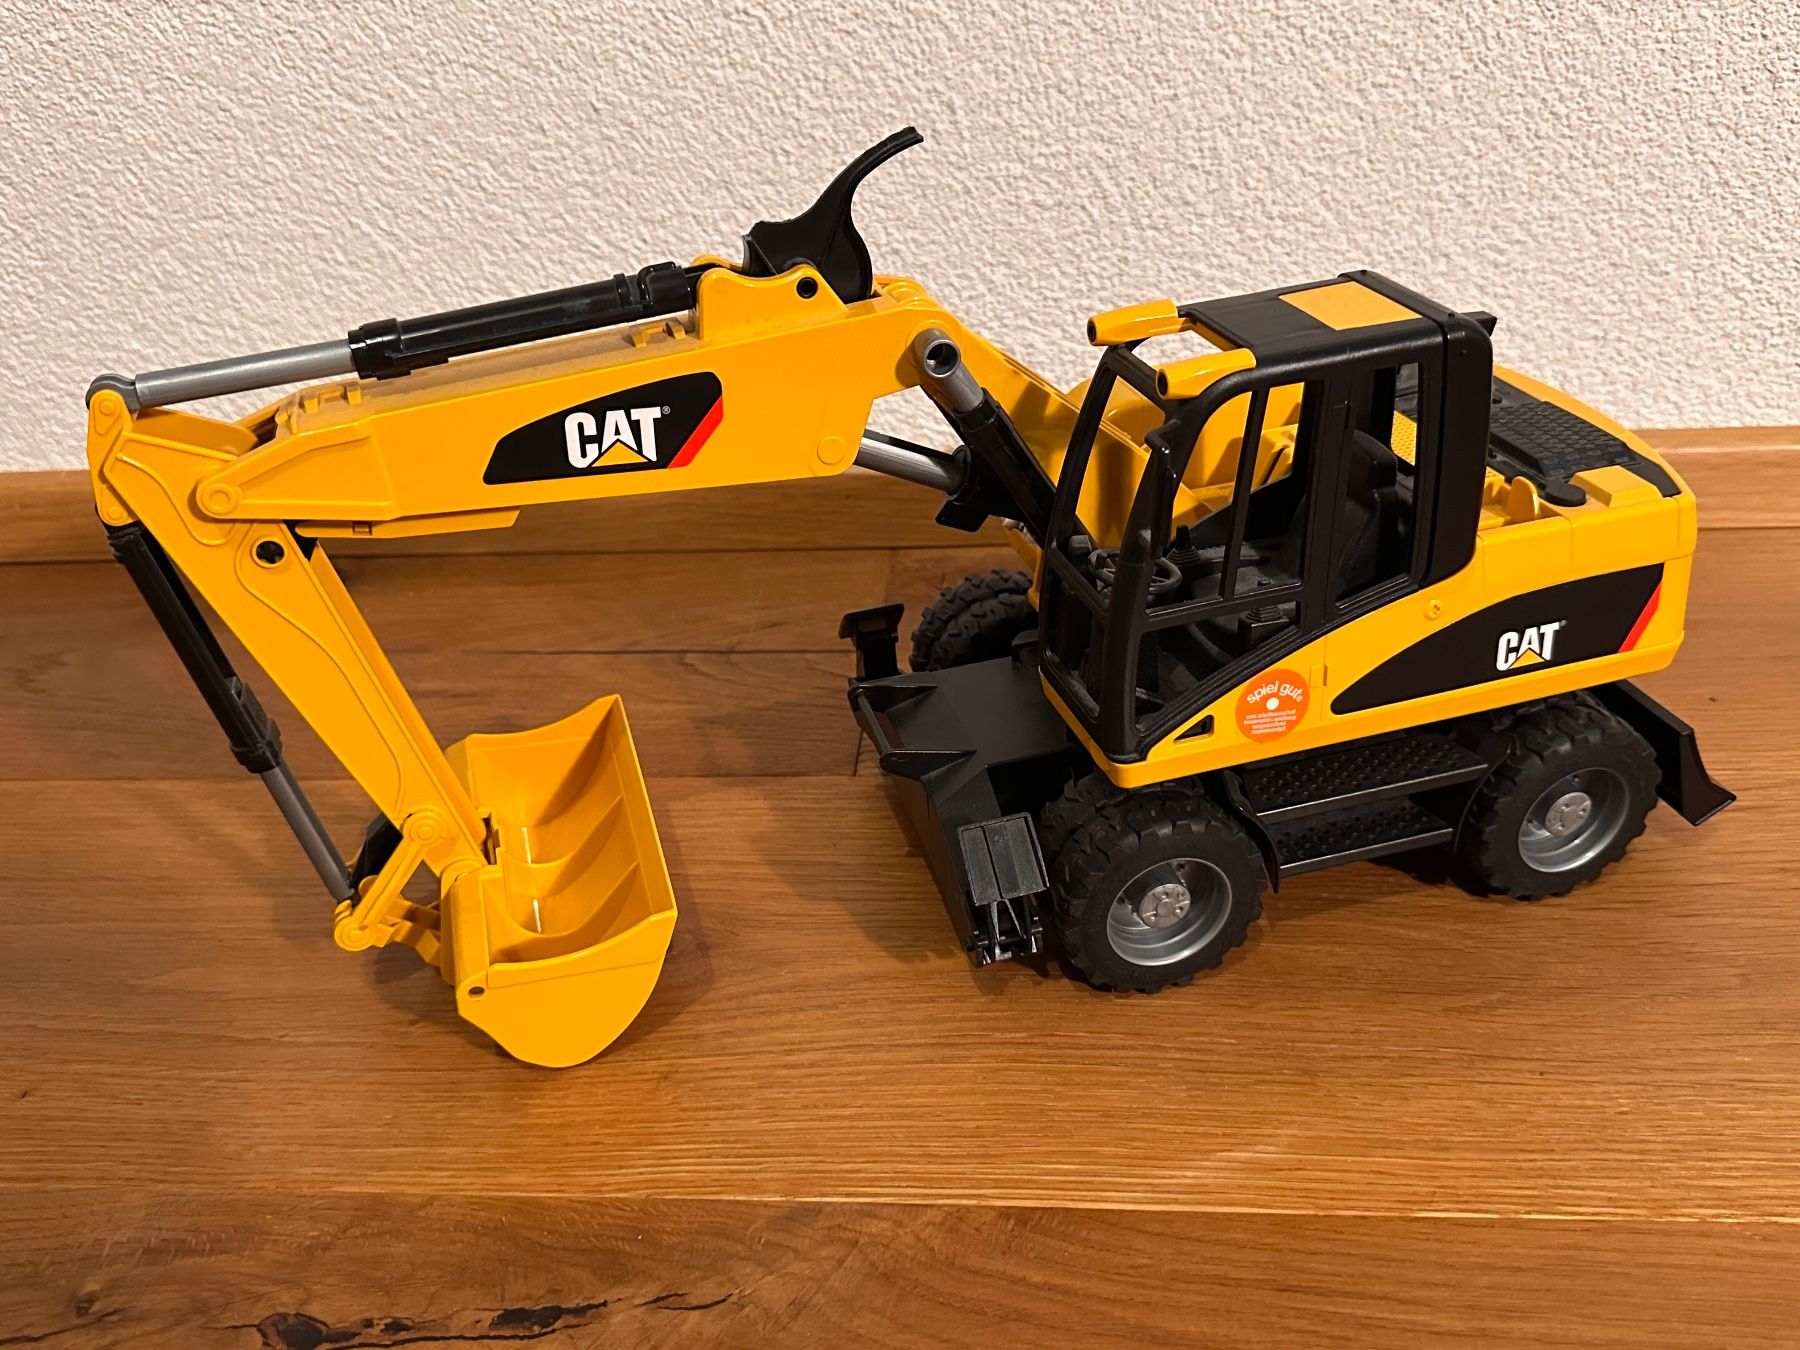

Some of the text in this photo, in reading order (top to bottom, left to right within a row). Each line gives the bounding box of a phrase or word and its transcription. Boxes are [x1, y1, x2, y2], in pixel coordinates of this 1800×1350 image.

[565, 406, 662, 469] CAT
[1496, 621, 1560, 671] CAT
[1247, 680, 1302, 704] spiel gut
